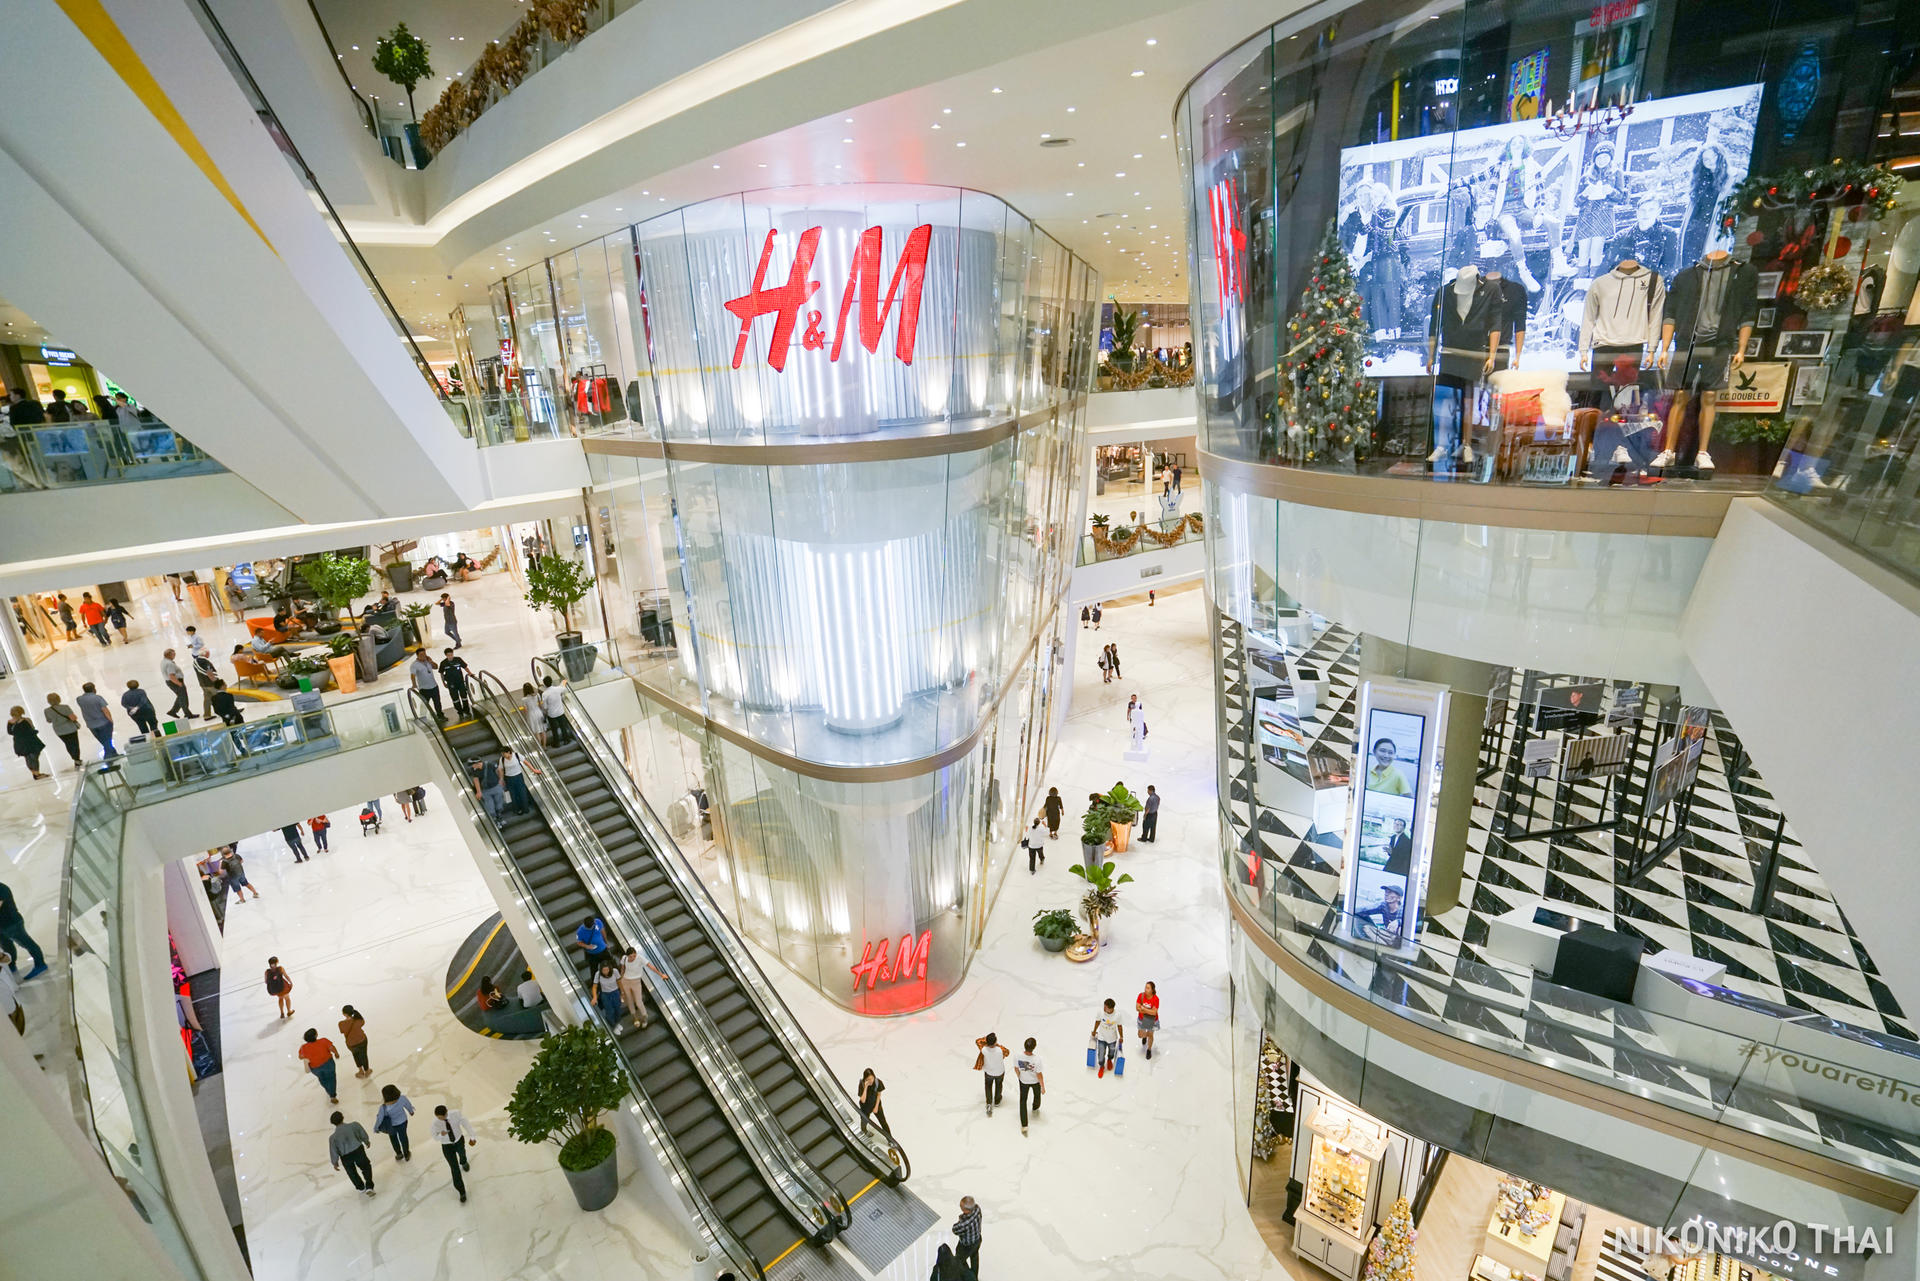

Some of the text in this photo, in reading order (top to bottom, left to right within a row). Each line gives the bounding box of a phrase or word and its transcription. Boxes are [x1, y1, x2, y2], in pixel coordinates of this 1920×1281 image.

[724, 224, 932, 373] H&M
[1719, 392, 1730, 401] CC
[1731, 392, 1763, 401] DOUBLE
[850, 929, 933, 992] H&M
[1689, 1214, 1840, 1277] JO MLONE
